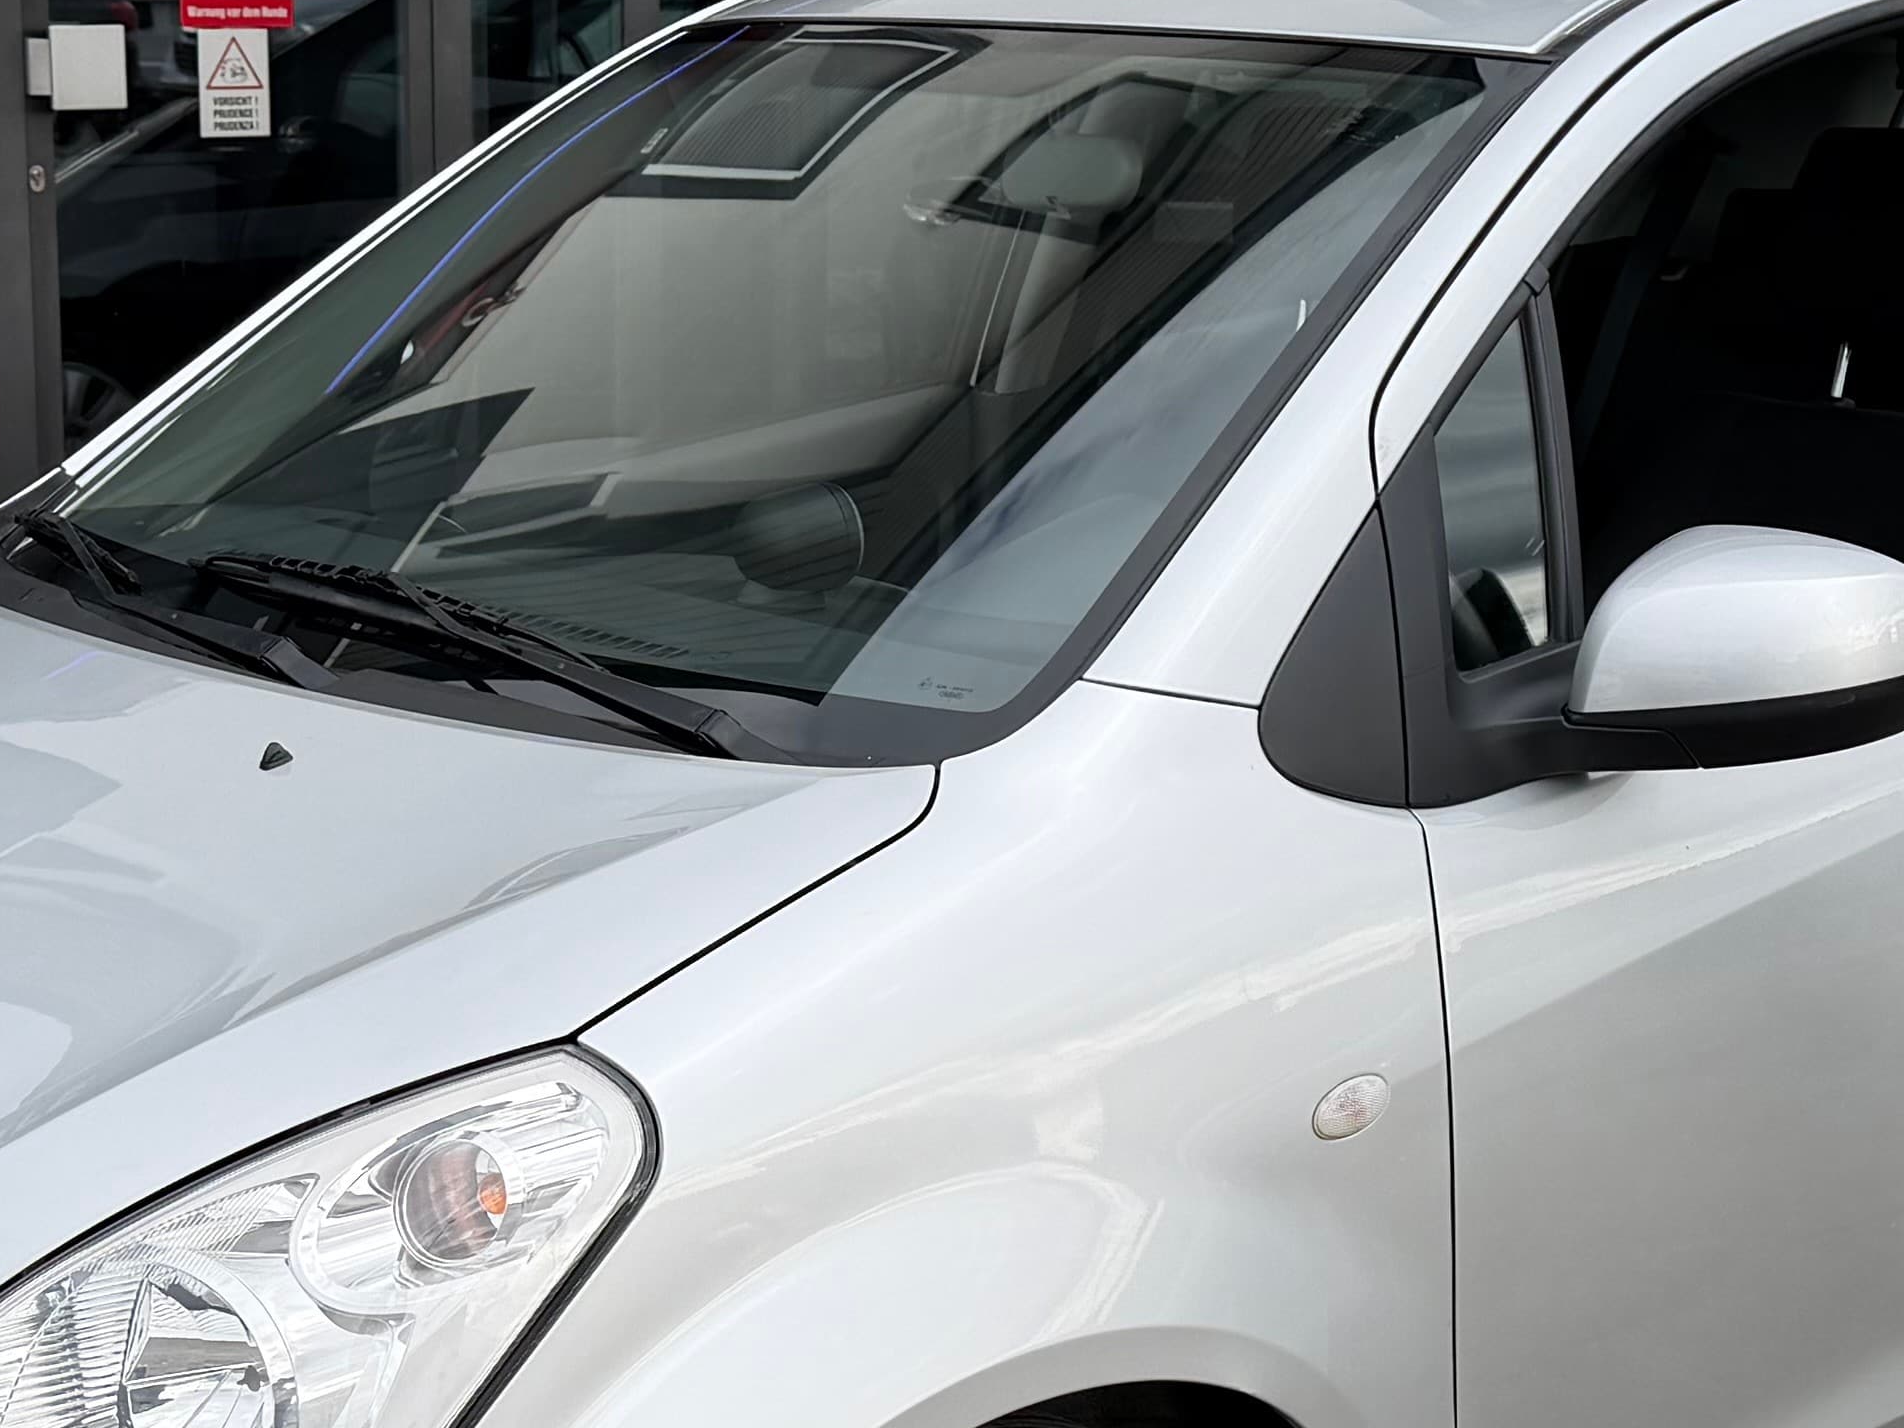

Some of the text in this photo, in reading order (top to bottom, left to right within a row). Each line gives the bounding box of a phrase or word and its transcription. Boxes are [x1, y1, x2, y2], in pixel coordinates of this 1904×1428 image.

[186, 4, 226, 20] Warnung
[227, 7, 242, 19] vor
[242, 6, 261, 19] dem
[212, 96, 253, 106] VORSICHT
[213, 108, 254, 118] PRUDENCE
[213, 121, 254, 131] PRUDENZA
